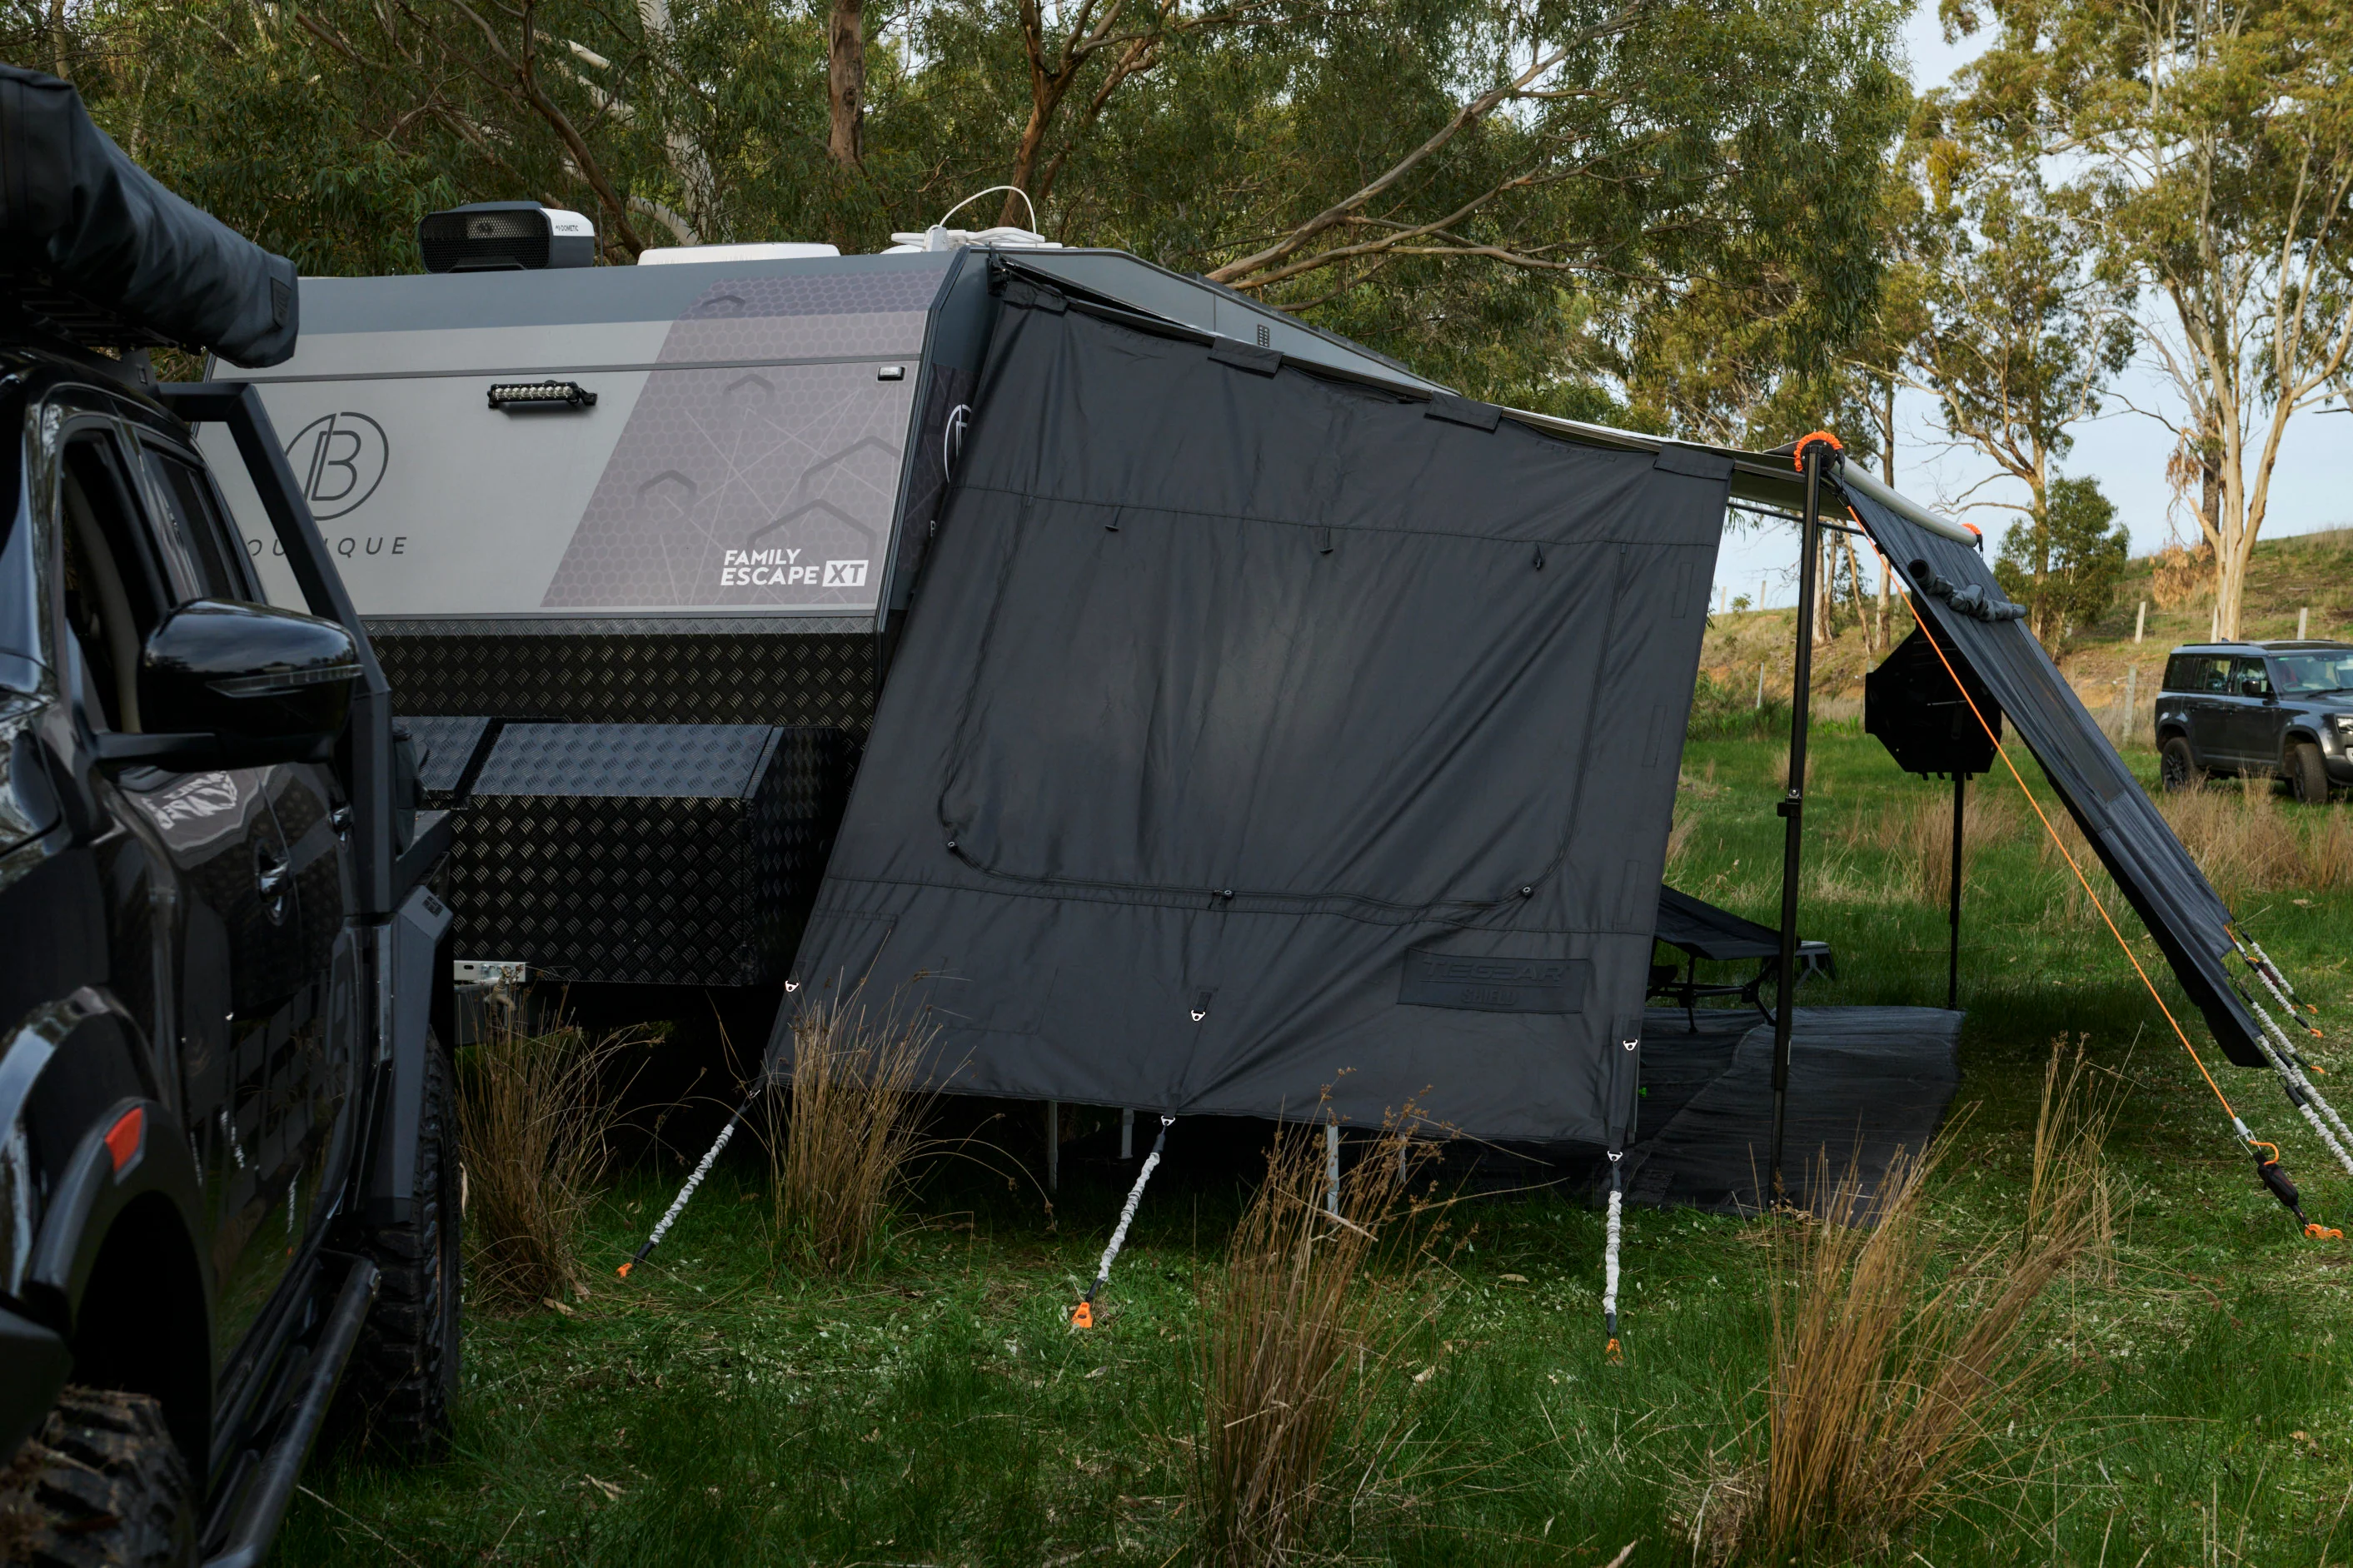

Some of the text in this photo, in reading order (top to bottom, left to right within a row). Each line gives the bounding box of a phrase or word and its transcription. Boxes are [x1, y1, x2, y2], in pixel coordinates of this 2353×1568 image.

[247, 536, 407, 559] OUQUE
[723, 548, 801, 566] FAMILY
[720, 563, 865, 586] ESCAPE XT
[1423, 959, 1565, 982] TIEGEAR
[1462, 987, 1518, 1006] SHIELD
